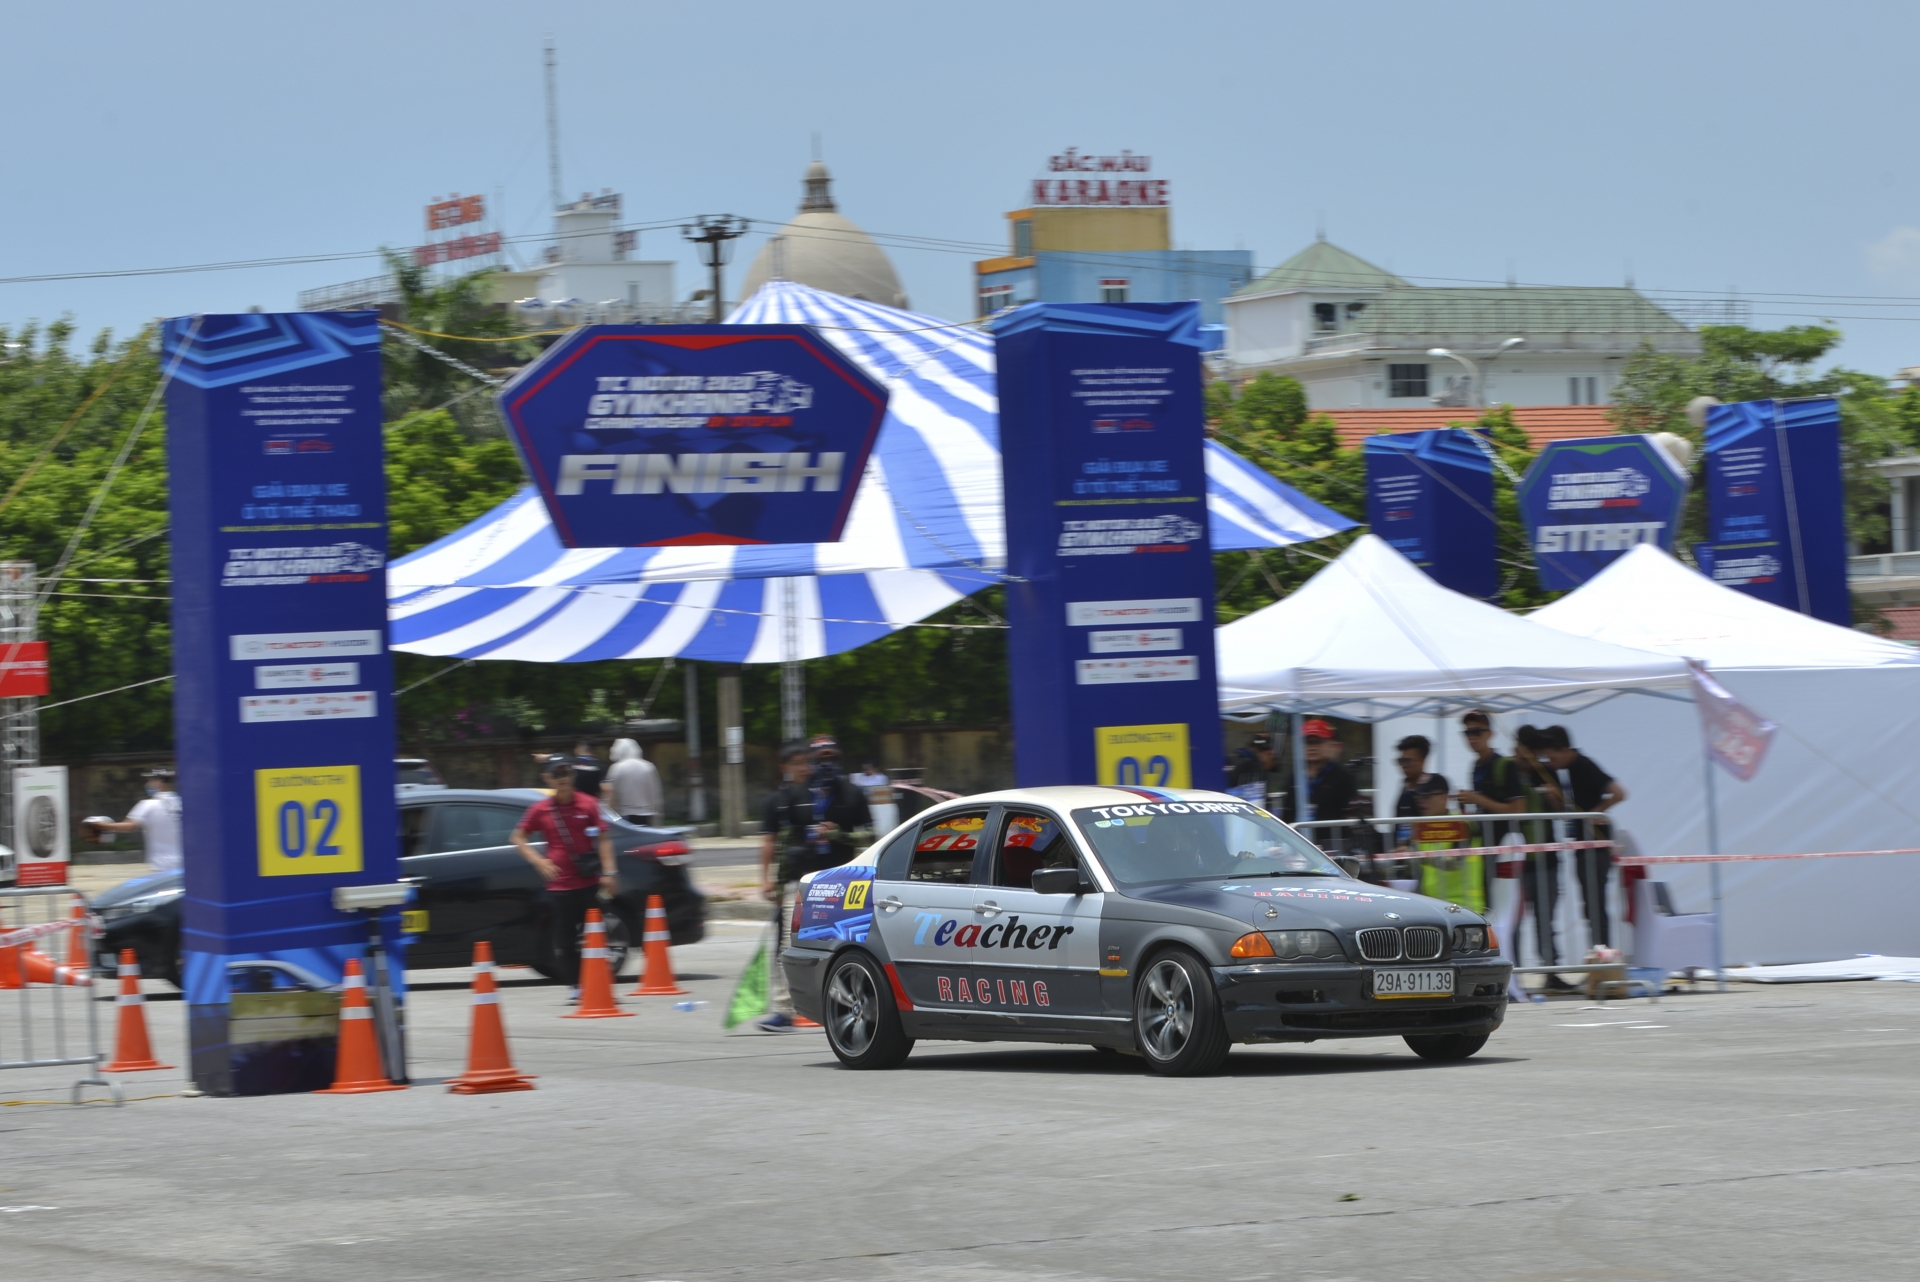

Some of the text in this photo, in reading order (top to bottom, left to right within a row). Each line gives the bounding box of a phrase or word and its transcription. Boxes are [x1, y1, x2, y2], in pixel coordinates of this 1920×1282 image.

[1032, 179, 1171, 205] KARAOKE
[628, 376, 704, 391] MOTOR
[588, 393, 751, 415] GYMKHANA
[555, 452, 847, 495] FINISH
[1535, 522, 1667, 553] START
[1092, 803, 1255, 819] TOKYO DRIFT
[278, 799, 344, 858] 02
[848, 884, 865, 905] 02
[1253, 891, 1373, 903] RACING
[913, 912, 1075, 951] Teacher
[937, 976, 1050, 1007] RACING
[1376, 972, 1452, 991] 29A-911.39
